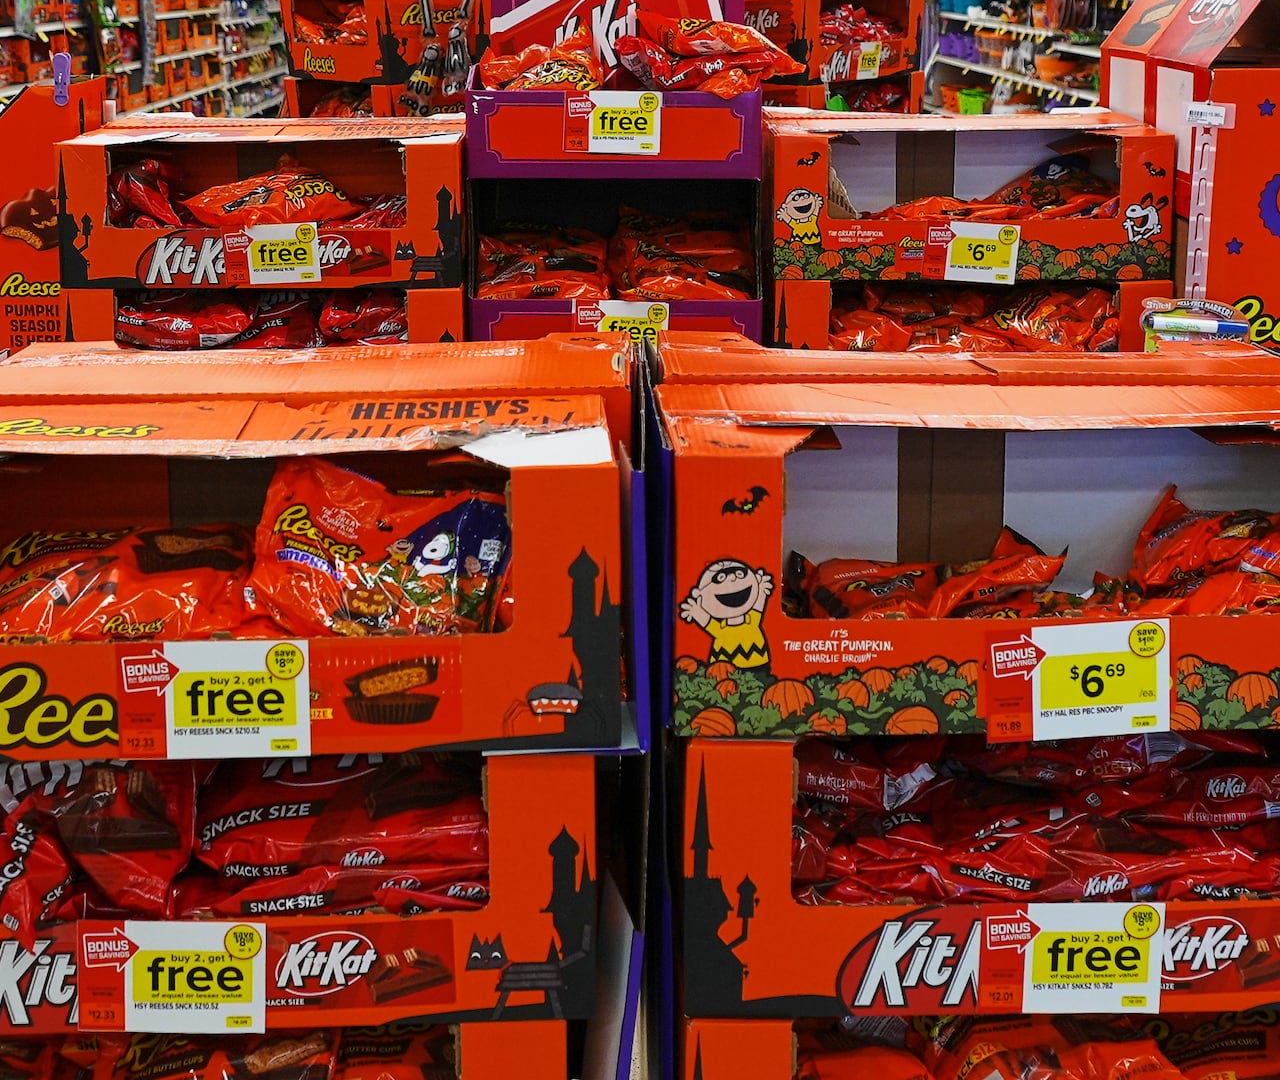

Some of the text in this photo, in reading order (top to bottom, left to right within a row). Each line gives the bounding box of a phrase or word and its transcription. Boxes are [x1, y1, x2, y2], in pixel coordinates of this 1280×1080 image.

[304, 47, 336, 74] Reese's
[861, 54, 877, 67] free
[600, 112, 647, 131] free
[258, 244, 308, 262] free
[608, 320, 657, 343] free
[350, 399, 529, 420] HERSHEY'S
[273, 505, 365, 563] Reese's
[102, 616, 164, 635] Reese's
[1137, 628, 1158, 636] save
[830, 629, 849, 639] IT'S
[274, 649, 296, 657] save
[784, 640, 802, 651] THE
[804, 640, 839, 652] GREAT
[996, 647, 1036, 662] BONUS
[127, 663, 169, 677] BONUS
[1006, 658, 1037, 668] SAVINGS
[210, 677, 230, 686] buy
[235, 677, 245, 685] 2,
[248, 677, 266, 686] get
[187, 680, 285, 717] free
[1055, 709, 1067, 718] HAL
[1069, 708, 1081, 716] RES
[1082, 708, 1094, 716] PBC
[1097, 705, 1123, 714] SNOOPY
[1206, 776, 1248, 798] KitKat
[201, 803, 311, 843] SNACK SIZE
[343, 851, 385, 866] KitKat
[225, 865, 288, 878] SNACK SIZE
[1005, 875, 1032, 891] SIZE
[1084, 873, 1128, 897] KitKat
[250, 899, 294, 913] SNACK
[990, 922, 1031, 935] BONUS
[1000, 932, 1031, 942] SAVINGS
[1071, 934, 1090, 944] buy
[1093, 934, 1105, 943] 2,
[1107, 934, 1125, 944] get
[87, 940, 129, 953] BONUS
[171, 954, 191, 964] buy
[194, 954, 206, 963] 2,
[208, 955, 225, 964] get
[1047, 938, 1141, 972] free
[277, 939, 378, 988] KitKat
[147, 956, 244, 993] free
[1048, 983, 1070, 991] KITKAT
[1071, 983, 1092, 991] SNKSZ
